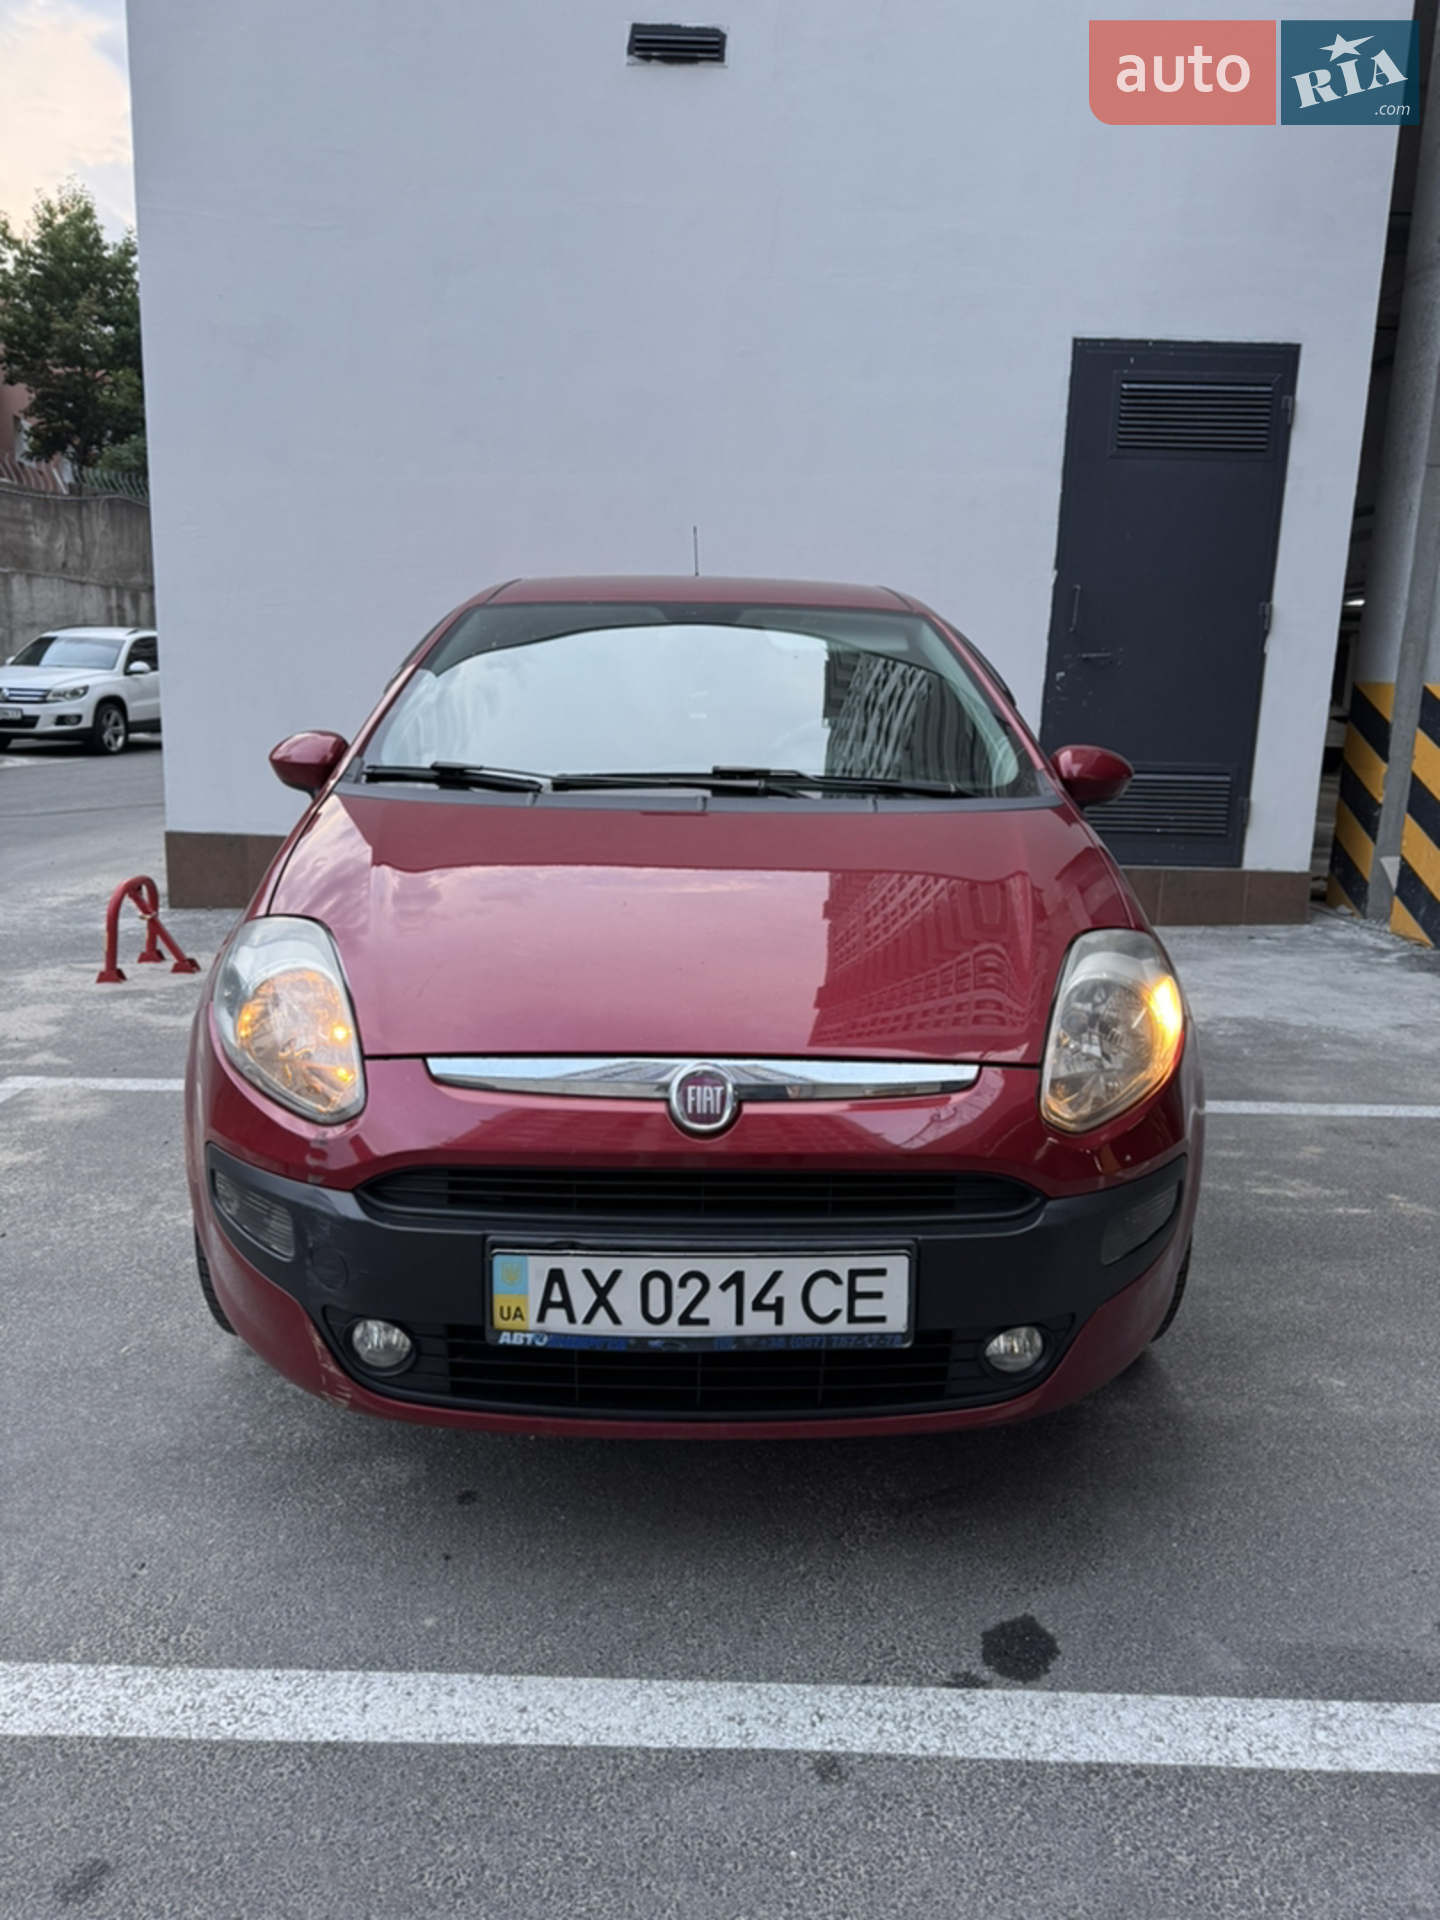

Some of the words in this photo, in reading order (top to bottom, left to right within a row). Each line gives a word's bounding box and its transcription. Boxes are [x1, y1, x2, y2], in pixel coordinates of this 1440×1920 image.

[687, 1085, 725, 1114] FIAT
[536, 1267, 623, 1326] AX
[640, 1269, 784, 1326] 0214
[801, 1268, 888, 1325] CE
[500, 1305, 526, 1321] UA
